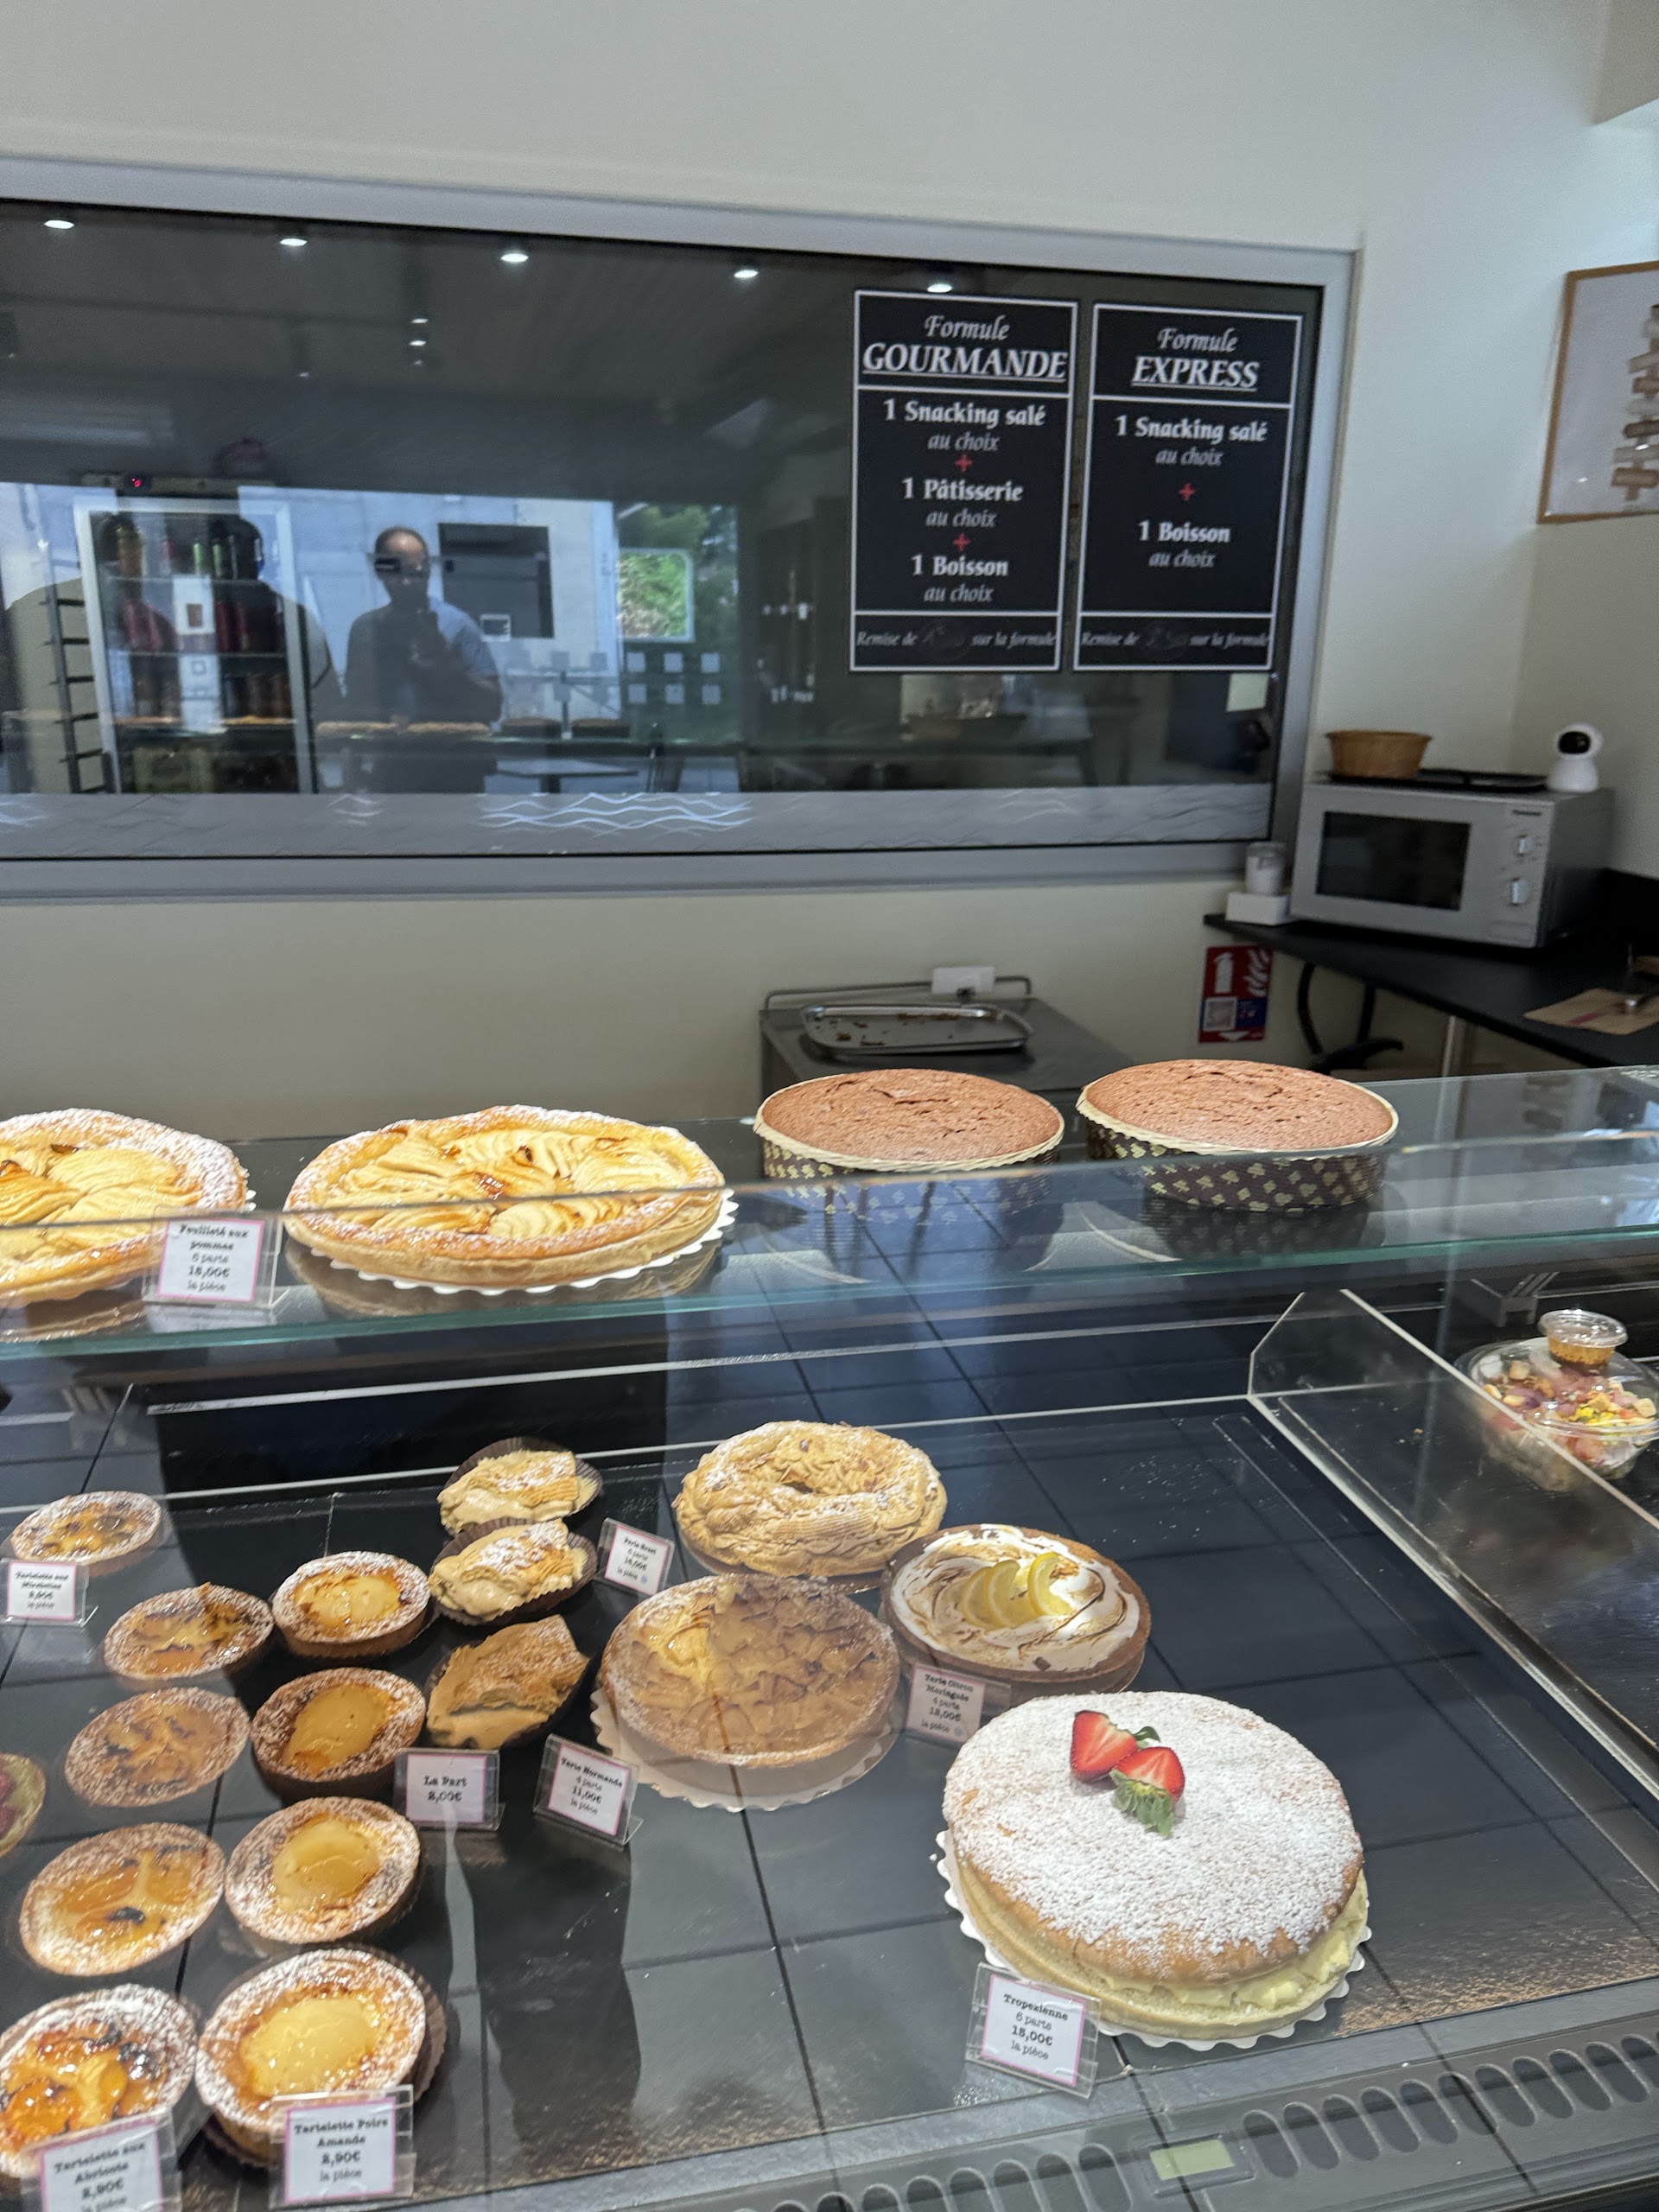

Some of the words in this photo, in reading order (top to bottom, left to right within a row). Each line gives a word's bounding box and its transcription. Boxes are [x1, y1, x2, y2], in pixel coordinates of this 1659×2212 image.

[925, 315, 1010, 341] Formule
[1157, 327, 1239, 353] Formule
[862, 342, 1069, 380] GOURMANDE
[1131, 355, 1260, 389] EXPRESS
[883, 398, 896, 422] 1
[904, 400, 1000, 430] Snacking
[1005, 404, 1047, 426] salé
[927, 434, 950, 450] au
[954, 432, 1001, 452] choix
[1116, 415, 1128, 436] 1
[1135, 416, 1225, 446] Snacking
[1229, 422, 1268, 442] salé
[1155, 448, 1178, 465] au
[1180, 446, 1224, 467] choix
[901, 477, 915, 499] 1
[923, 477, 1026, 502] Pâtisserie
[925, 511, 949, 528] au
[952, 508, 998, 529] choix
[1138, 519, 1150, 541] 1
[1158, 522, 1231, 543] Boisson
[910, 554, 924, 576] 1
[932, 556, 1009, 577] Boisson
[1148, 551, 1171, 568] au
[1173, 549, 1217, 569] choix
[923, 587, 947, 603] au
[950, 583, 995, 603] choix
[423, 1774, 439, 1787] La
[442, 1775, 468, 1788] Part
[1015, 2011, 1023, 2022] 6
[1024, 2014, 1052, 2031] parts
[1010, 2039, 1020, 2051] la
[1021, 2043, 1050, 2061] pièce
